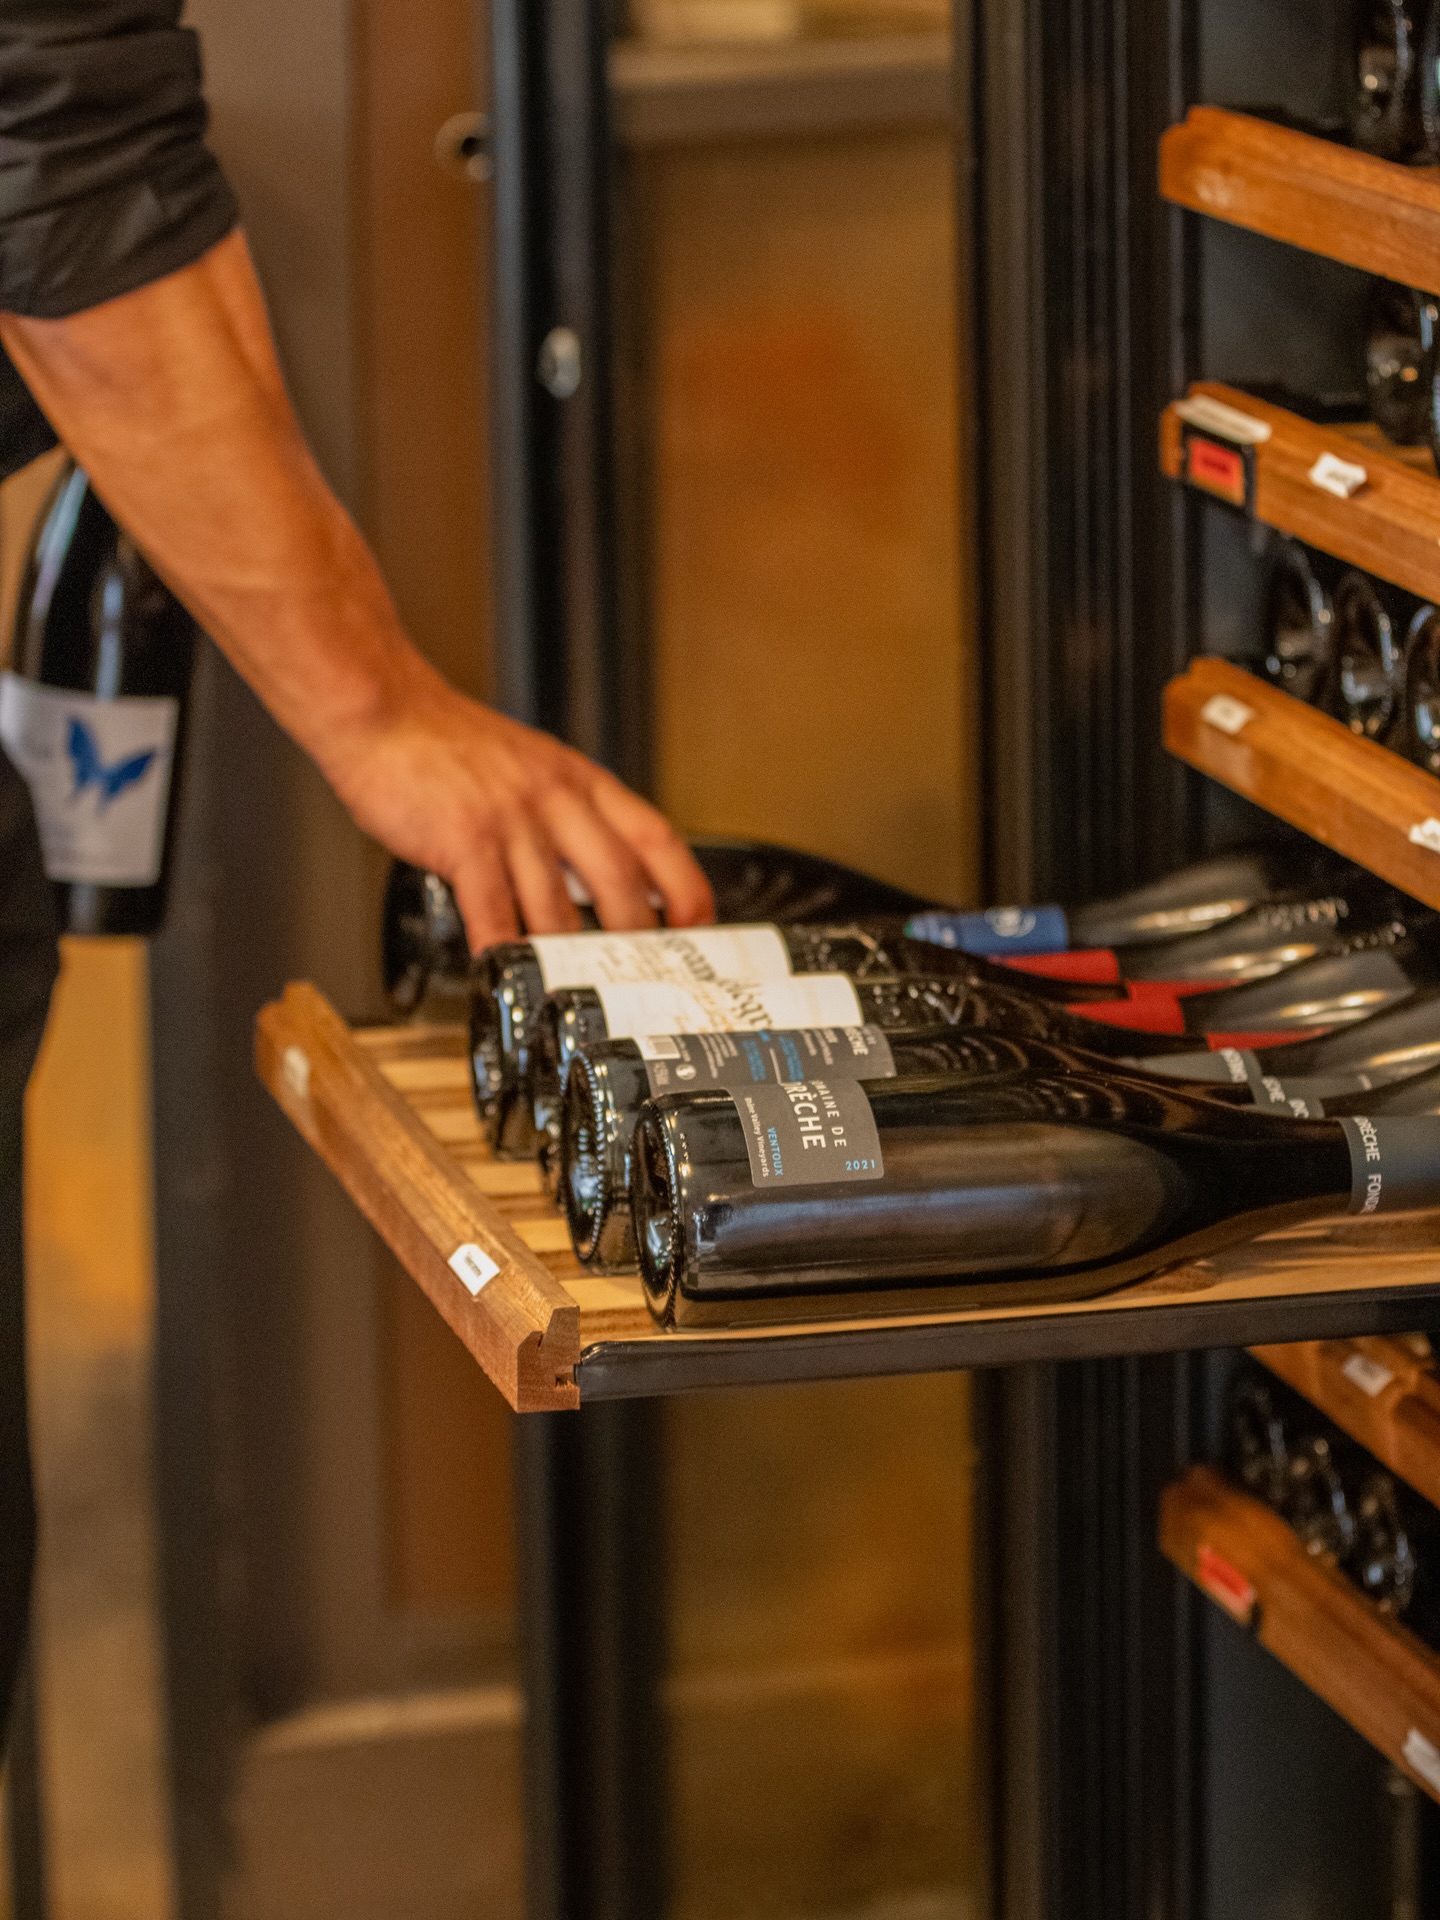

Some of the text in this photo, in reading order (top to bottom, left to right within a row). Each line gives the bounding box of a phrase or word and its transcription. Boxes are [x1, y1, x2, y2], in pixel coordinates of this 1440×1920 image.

[751, 1113, 761, 1136] Valley
[757, 1135, 770, 1178] Vineyards
[767, 1127, 784, 1177] VENTOUX
[831, 1126, 847, 1148] DE
[845, 1159, 876, 1171] 2021
